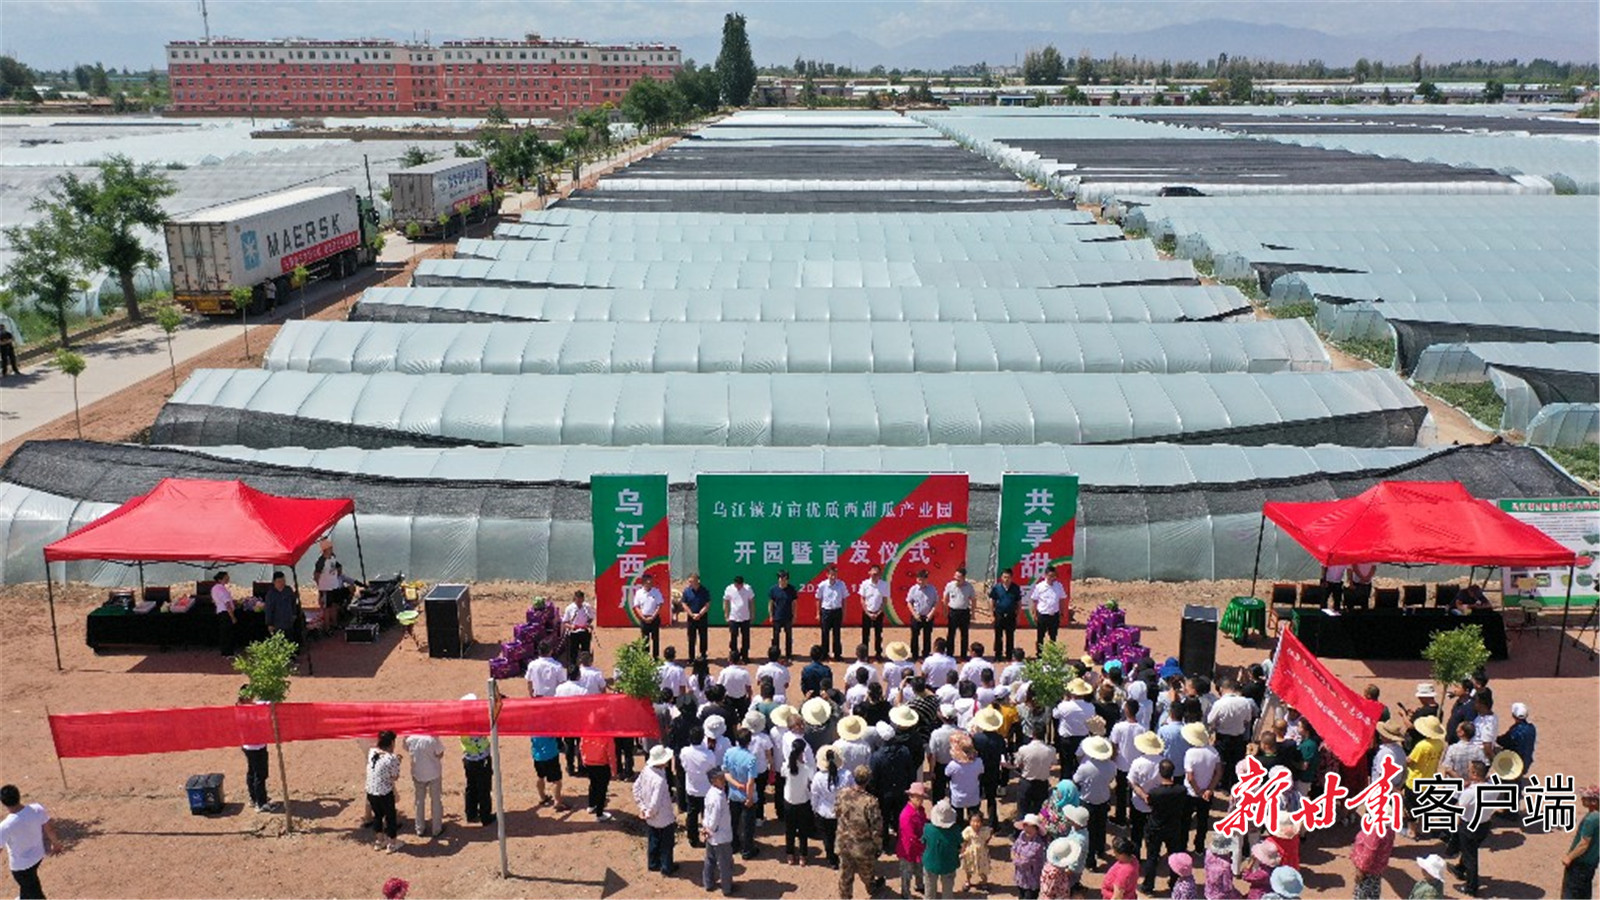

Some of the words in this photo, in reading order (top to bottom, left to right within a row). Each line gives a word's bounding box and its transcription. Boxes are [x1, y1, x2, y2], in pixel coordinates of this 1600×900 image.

[266, 213, 341, 258] MAERSK
[713, 500, 953, 519] 乌江镇万亩优质西甜瓜产业园
[733, 540, 931, 565] 开园暨首发仪式
